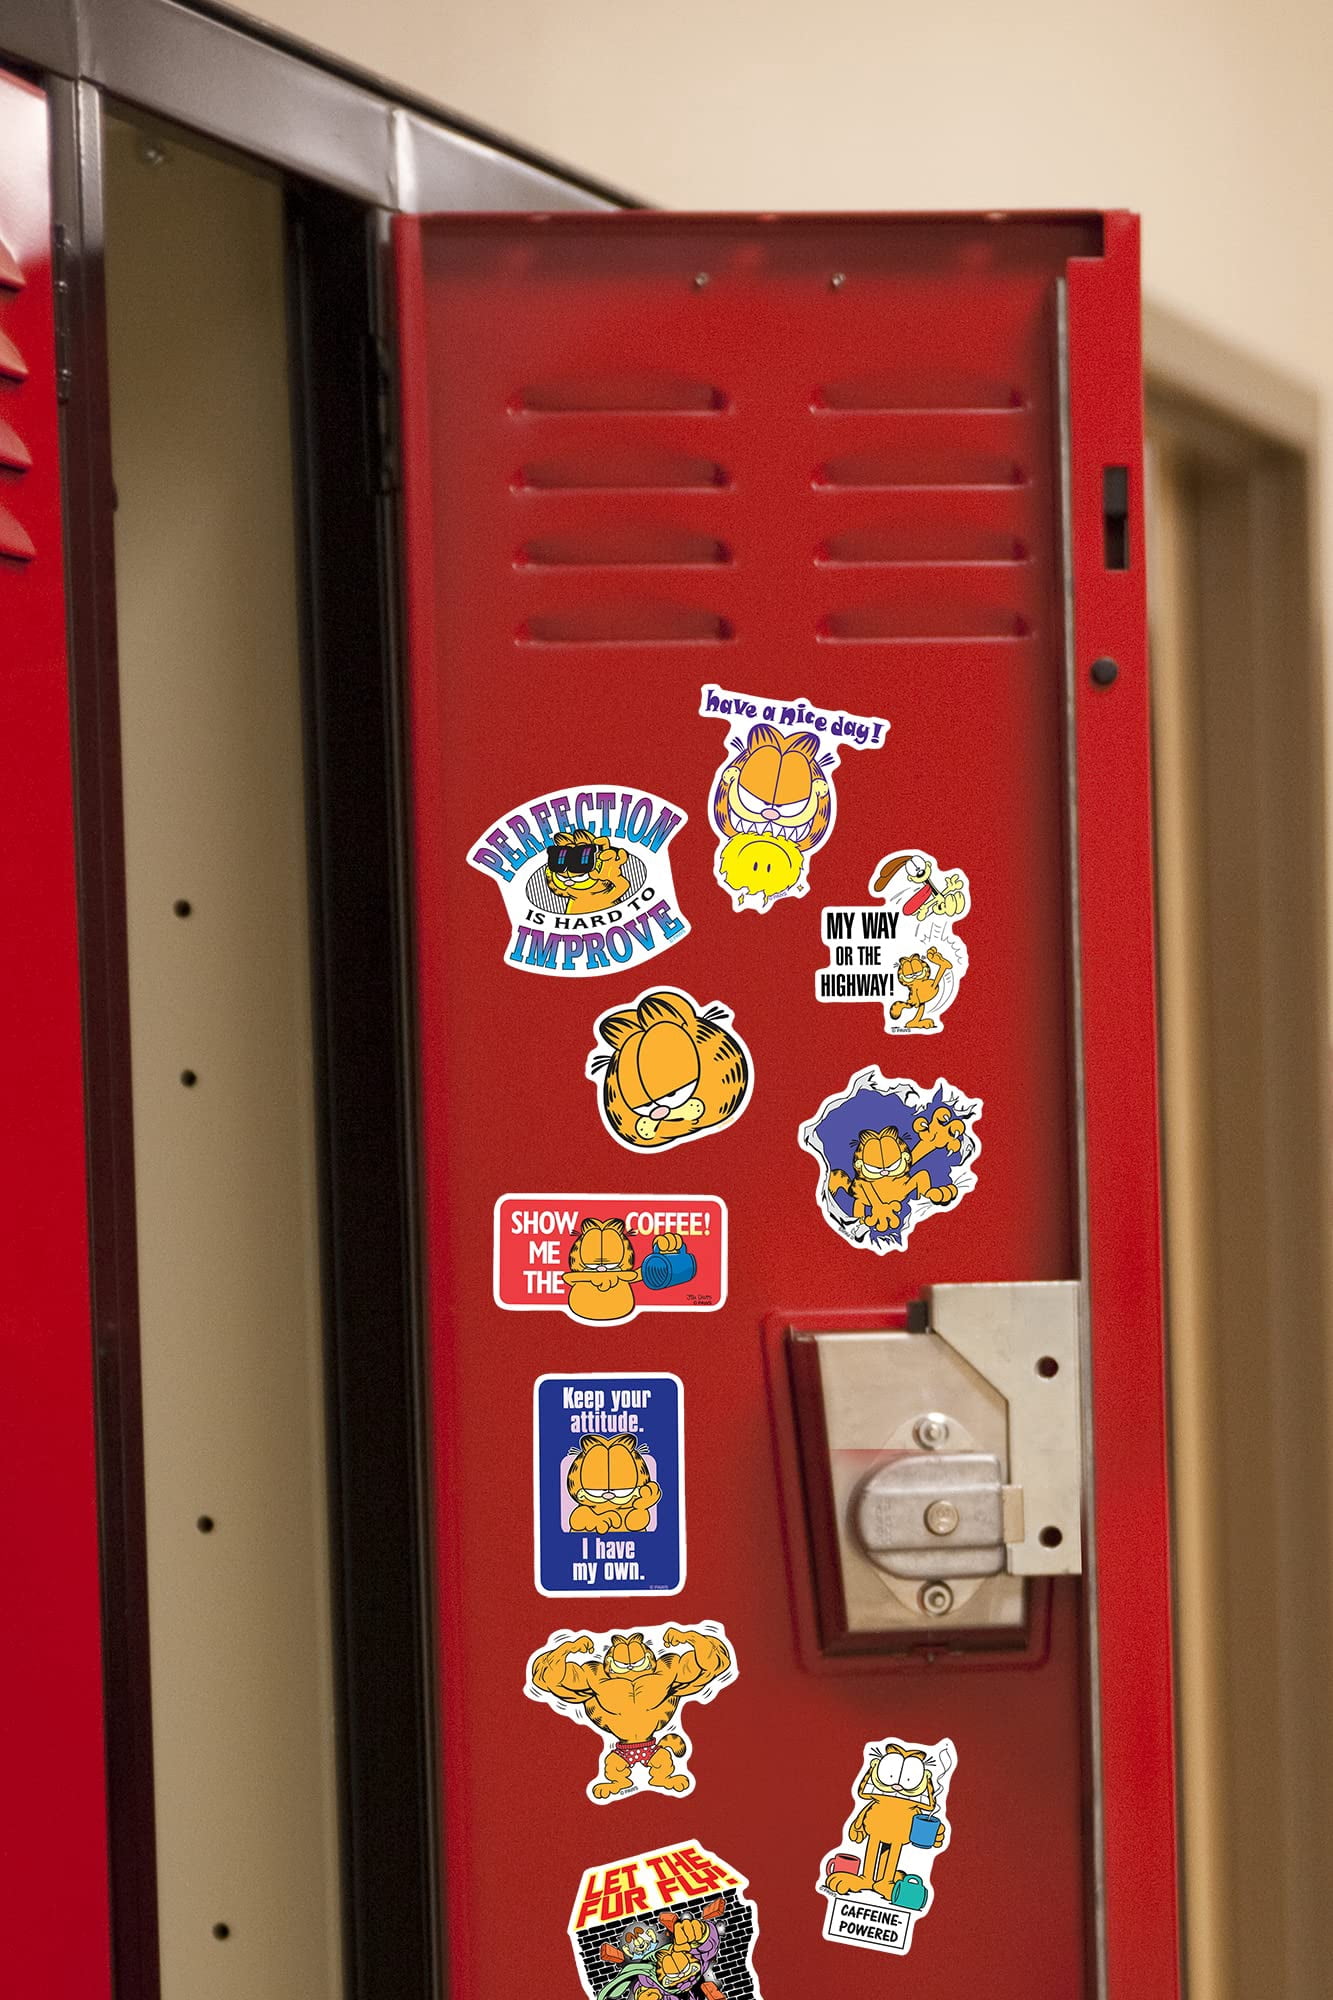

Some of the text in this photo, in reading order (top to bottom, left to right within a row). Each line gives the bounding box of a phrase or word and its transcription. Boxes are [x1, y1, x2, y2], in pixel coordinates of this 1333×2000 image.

[705, 689, 885, 745] have a nice day!
[472, 792, 682, 883] PERFECTION
[525, 887, 656, 930] IS HARD TO
[509, 899, 685, 970] IMPROVE
[826, 912, 899, 939] MY WAY
[836, 946, 881, 966] OR THE
[820, 973, 894, 997] HIGHWAY!
[511, 1210, 711, 1236] SHOW COFFEE!
[529, 1241, 560, 1265] ME
[523, 1270, 565, 1294] THE
[562, 1386, 651, 1412] Keep your
[570, 1411, 644, 1433] attitude.
[582, 1537, 635, 1559] I have
[572, 1562, 645, 1584] my own.
[584, 1848, 712, 1901] LET THE
[575, 1865, 738, 1929] FUR FLY!
[840, 1904, 902, 1926] CAFFEINE-
[838, 1920, 898, 1942] POWERED
